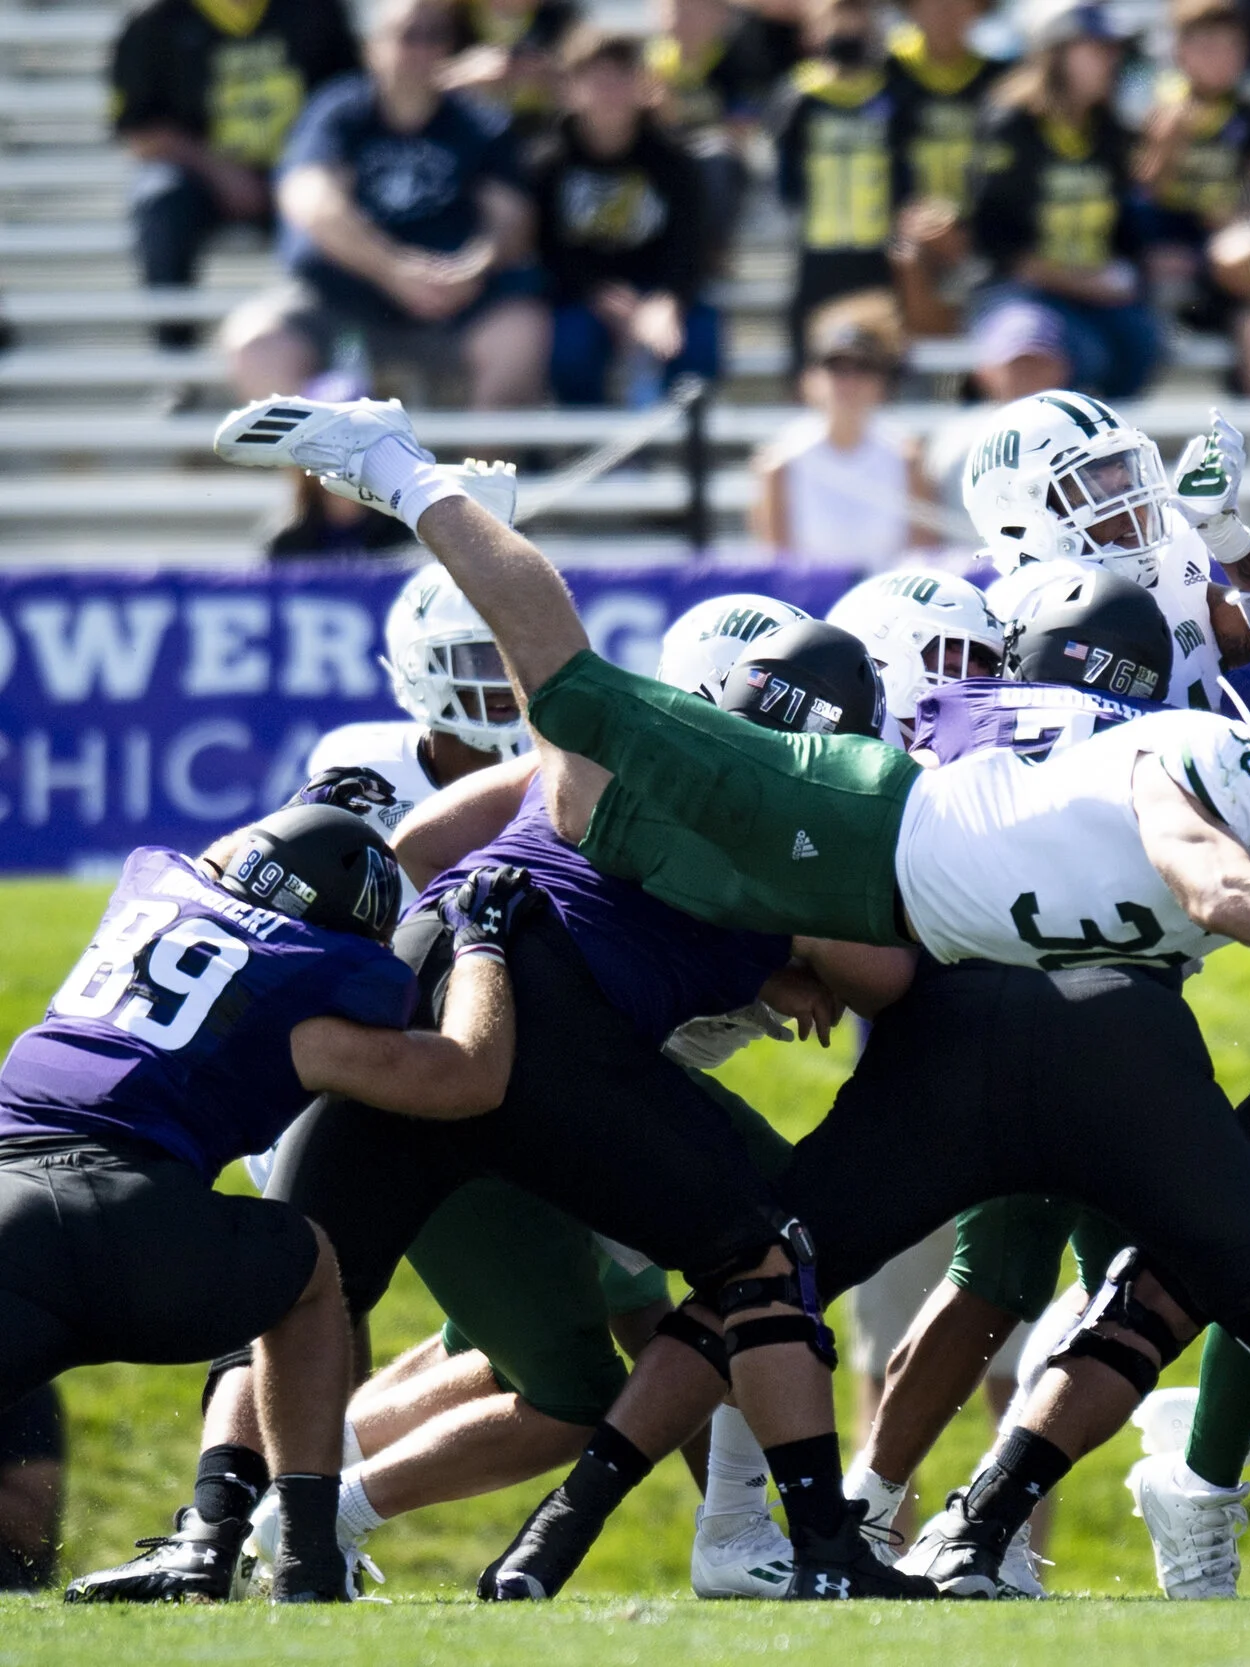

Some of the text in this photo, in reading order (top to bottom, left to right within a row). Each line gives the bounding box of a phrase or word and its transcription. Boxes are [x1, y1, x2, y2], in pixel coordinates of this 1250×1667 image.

[972, 430, 1020, 488] OHIO
[1084, 647, 1137, 695] 76
[759, 677, 806, 725] 71
[236, 848, 285, 899] 89
[52, 899, 251, 1052] 89
